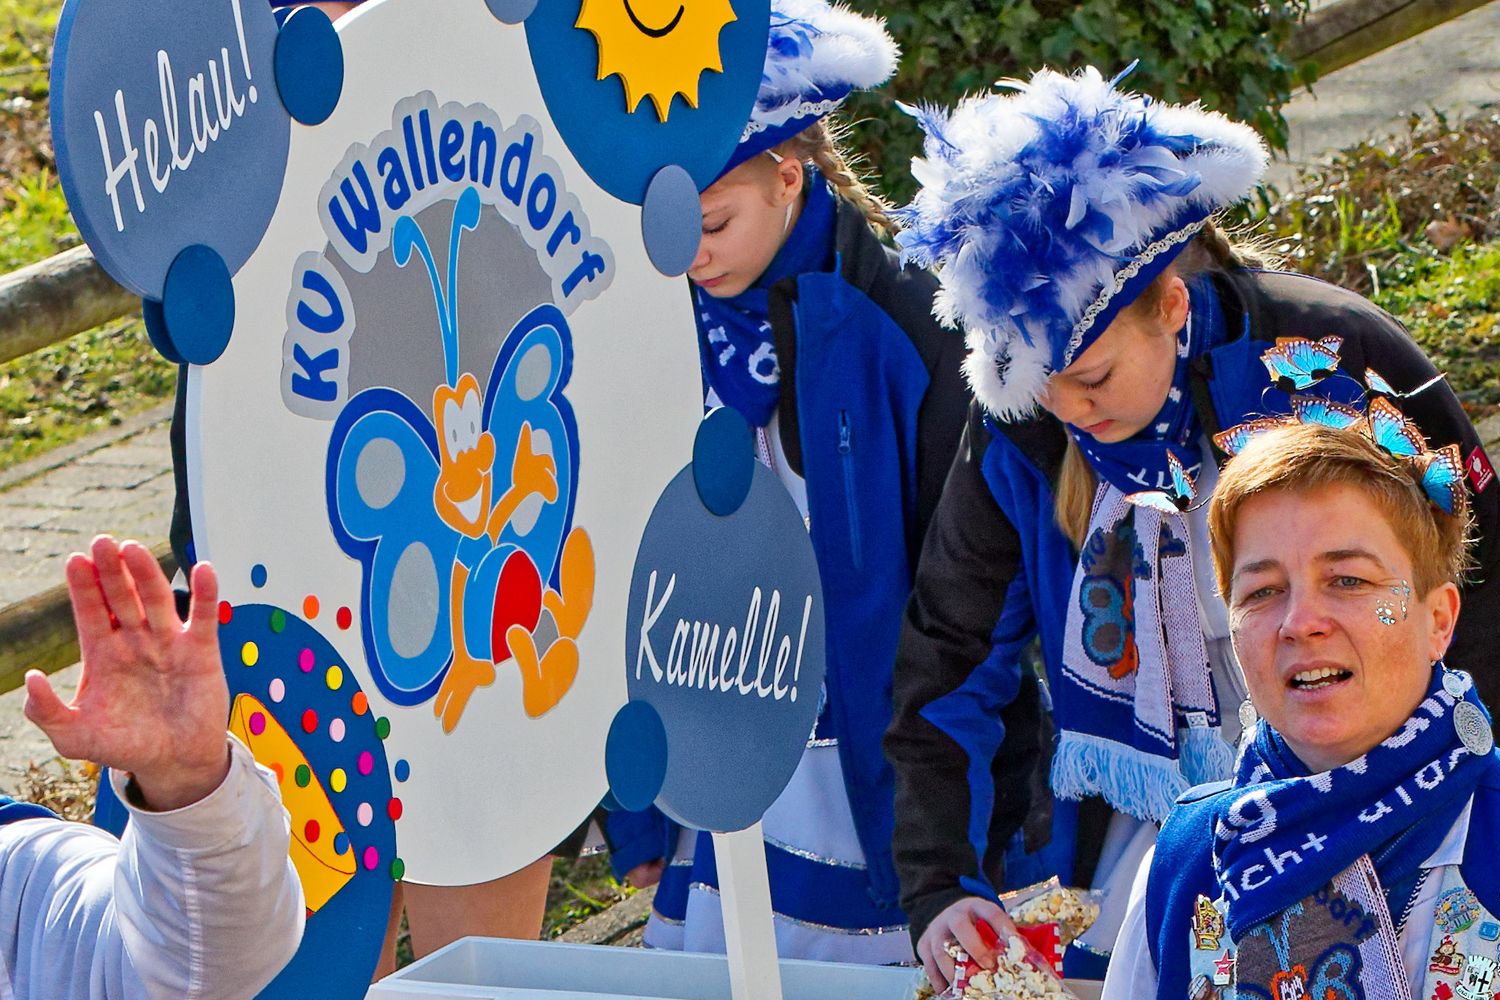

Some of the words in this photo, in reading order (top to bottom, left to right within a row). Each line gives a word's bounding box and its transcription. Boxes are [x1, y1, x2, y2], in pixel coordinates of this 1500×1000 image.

[94, 0, 257, 232] Helau!
[327, 108, 606, 299] Wallendorf
[635, 569, 813, 703] Kamelle!
